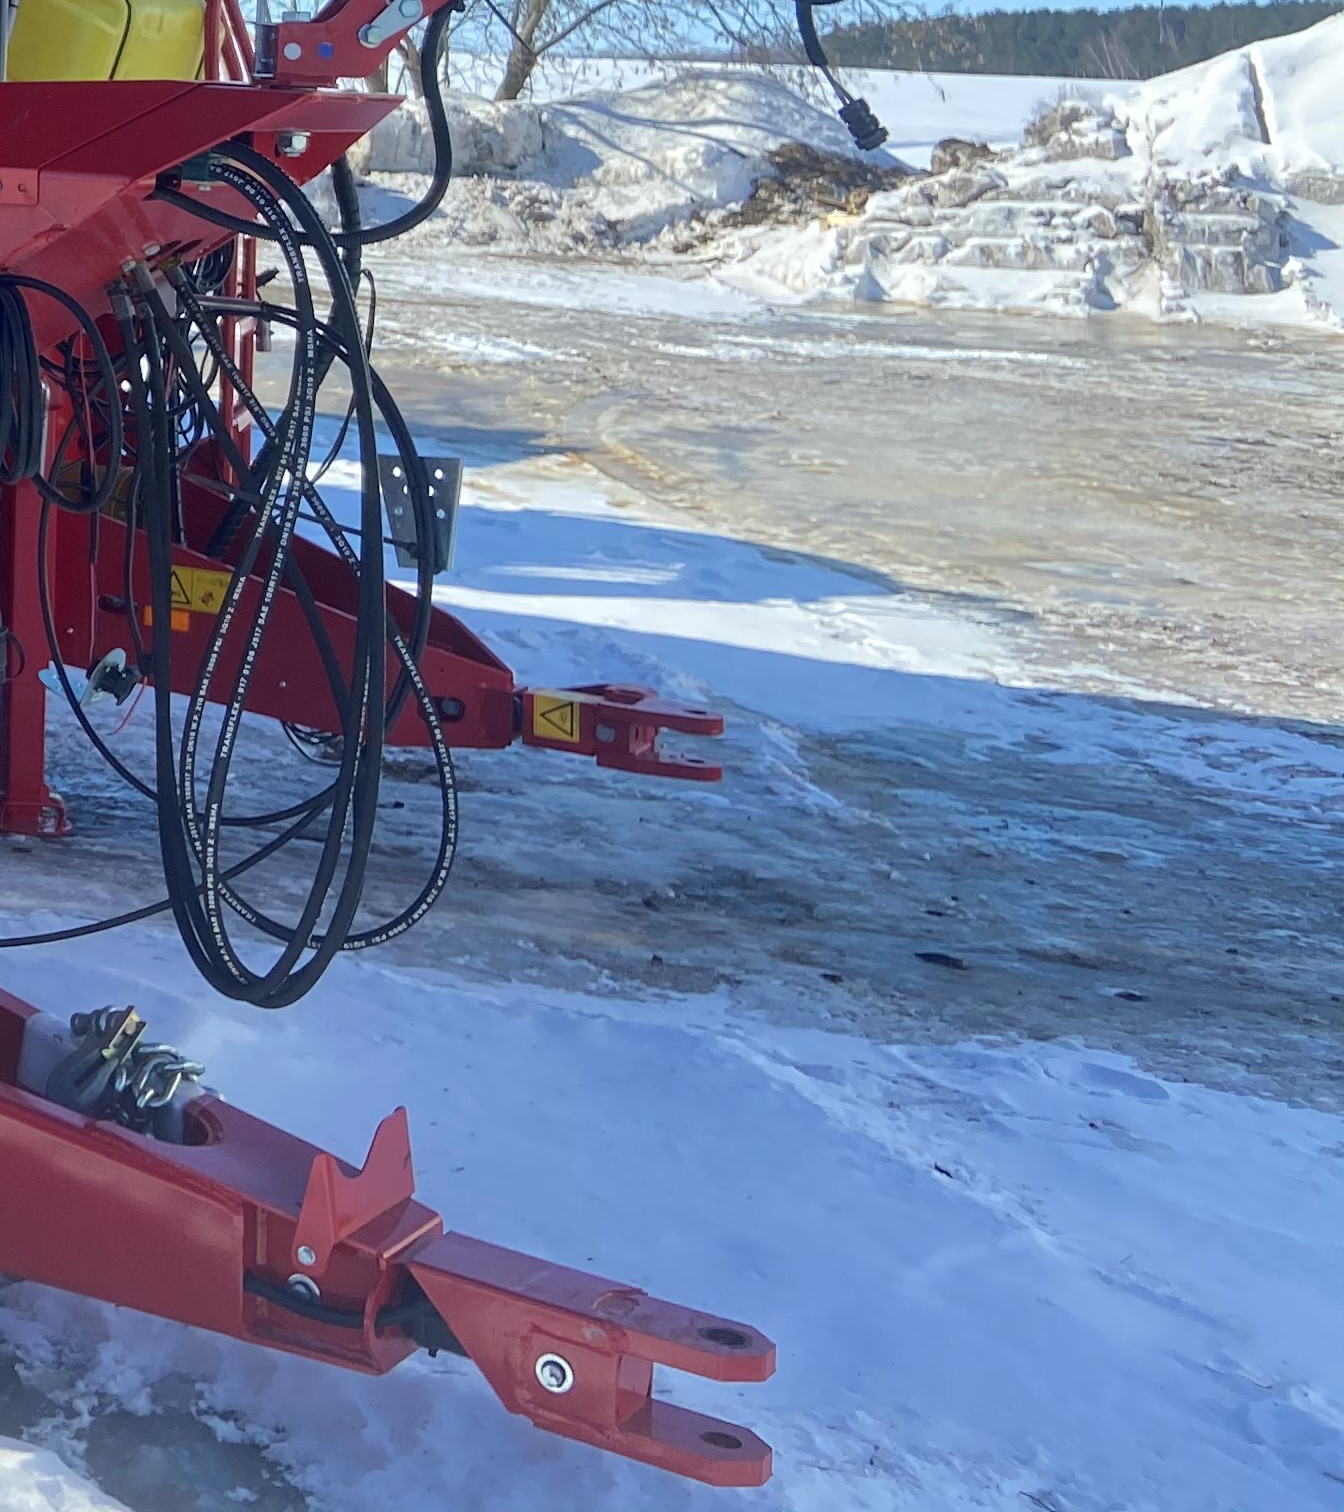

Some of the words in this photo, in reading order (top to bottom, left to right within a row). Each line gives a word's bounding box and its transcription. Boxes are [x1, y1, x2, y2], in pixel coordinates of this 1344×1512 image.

[278, 228, 304, 284] TRANSFLEX
[306, 328, 314, 358] MSHA
[304, 406, 312, 423] PSI
[296, 457, 305, 478] BAR
[255, 488, 278, 538] TRANSFLEX
[286, 498, 298, 519] W.P.
[280, 521, 292, 547] DN10
[258, 605, 269, 626] SAE
[199, 678, 210, 696] BAR
[220, 701, 240, 758] TRANSFLEX
[394, 634, 424, 689] TRANSFLEX
[412, 902, 429, 920] BAR
